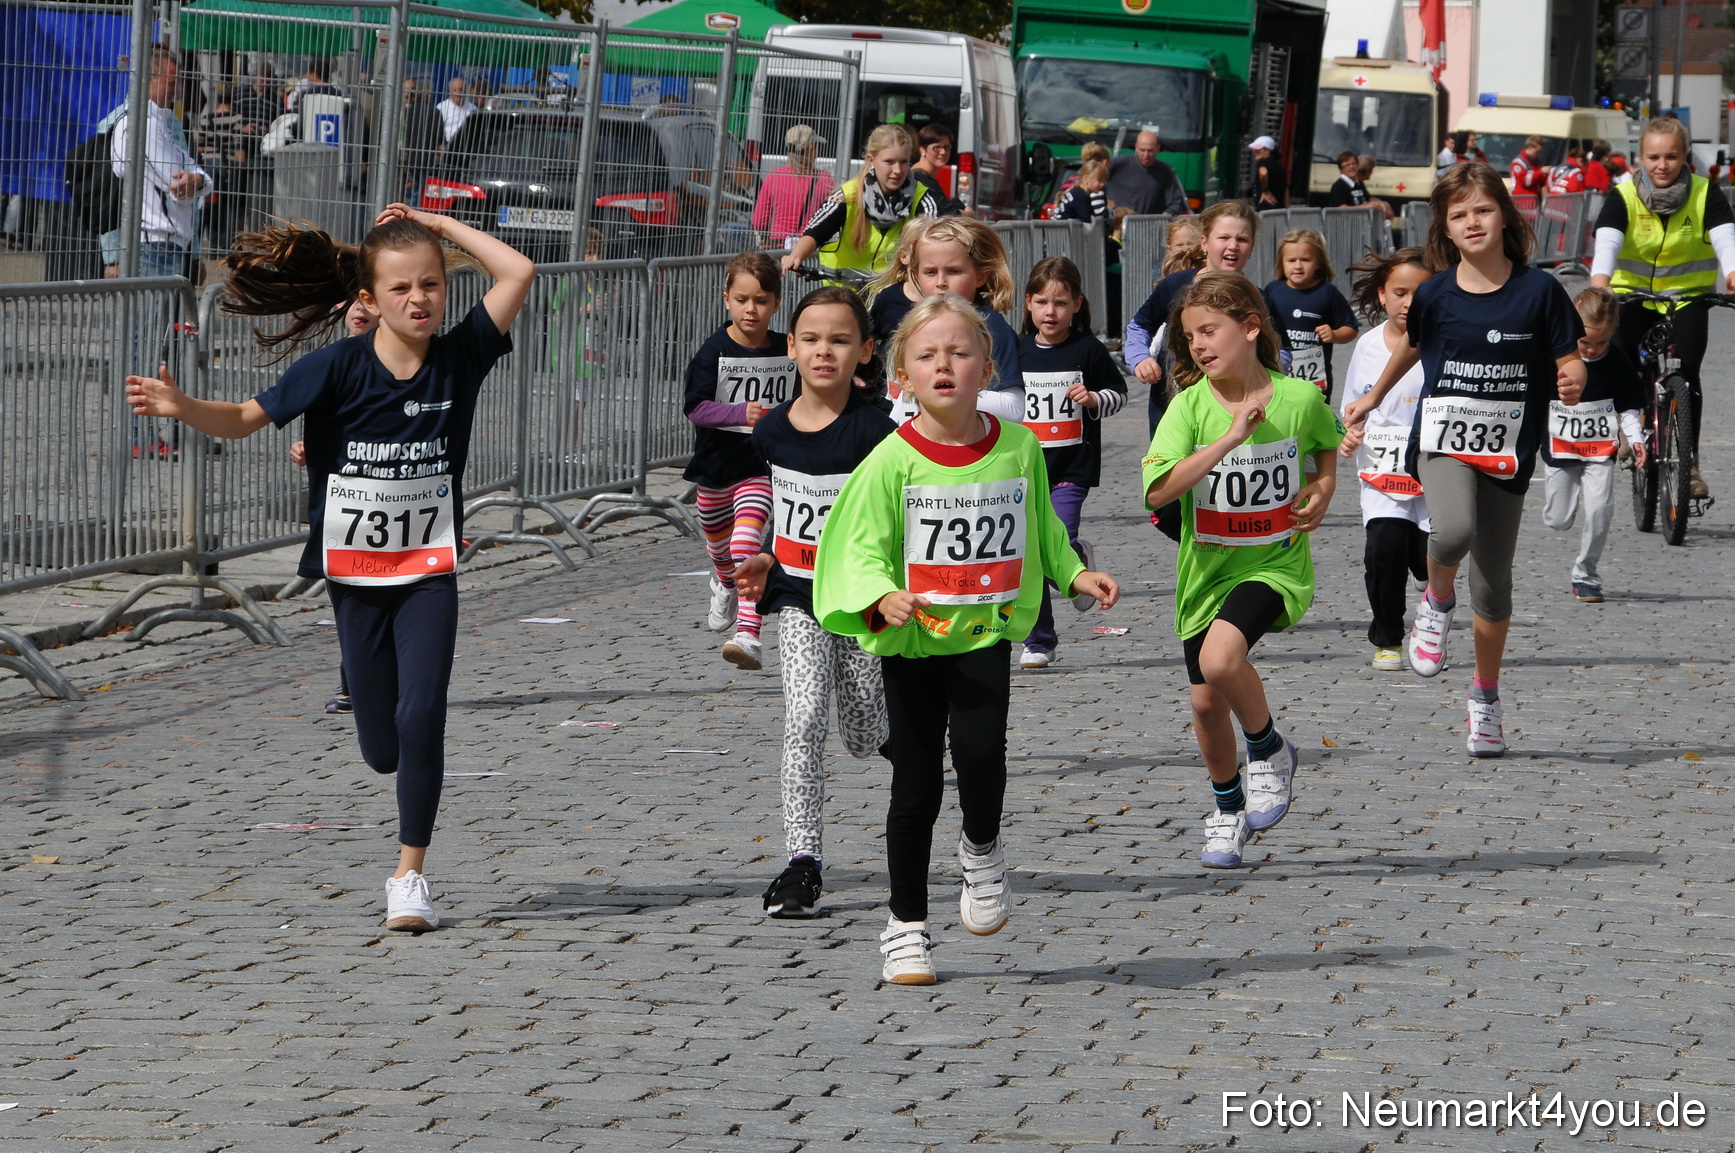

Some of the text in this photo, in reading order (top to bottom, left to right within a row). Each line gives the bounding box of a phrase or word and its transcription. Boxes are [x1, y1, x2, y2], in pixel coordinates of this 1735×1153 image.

[320, 120, 335, 142] P
[721, 365, 786, 373] PARTL Neumarkt
[728, 375, 787, 404] 7040
[1030, 380, 1069, 388] Neumarkt
[1453, 379, 1479, 392] Haus
[1027, 393, 1074, 420] 314
[1425, 405, 1507, 418] PARTL Neumarkt
[1573, 407, 1604, 416] Neumarkt
[1558, 415, 1610, 439] 7038
[1437, 420, 1507, 453] 7333
[1232, 451, 1284, 466] Neumarkt
[363, 464, 395, 479] Haus
[773, 476, 841, 497] PARTL Neuma
[1207, 464, 1289, 507] 7029
[330, 487, 432, 502] PARTL Neumarkt
[907, 494, 1010, 510] PARTL Neumarkt
[341, 506, 439, 548] 7317
[1228, 517, 1272, 533] Luisa
[920, 512, 1016, 561] 7322
[351, 556, 400, 574] Melina
